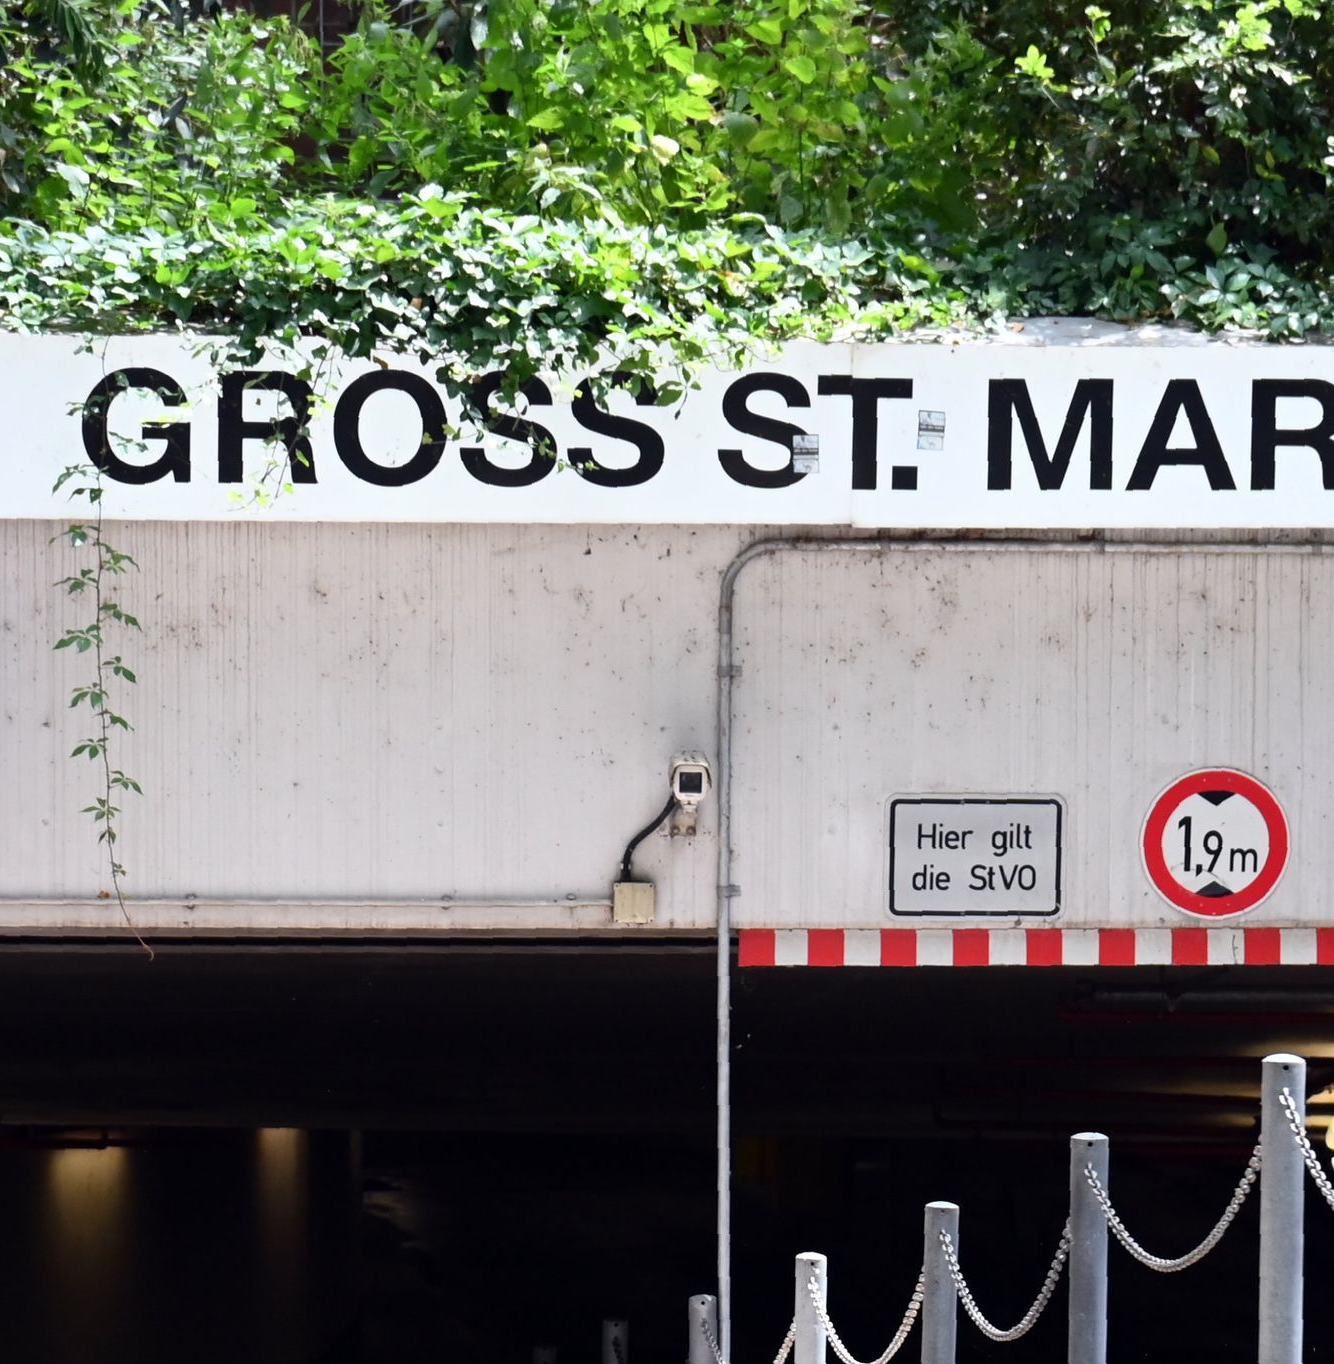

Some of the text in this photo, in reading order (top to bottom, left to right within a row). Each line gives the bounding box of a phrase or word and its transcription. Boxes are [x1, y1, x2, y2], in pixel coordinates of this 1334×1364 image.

[82, 367, 665, 488] GROSS
[718, 372, 918, 490] ST.
[917, 823, 1033, 857] Hier gilt
[912, 864, 1037, 891] die StVO
